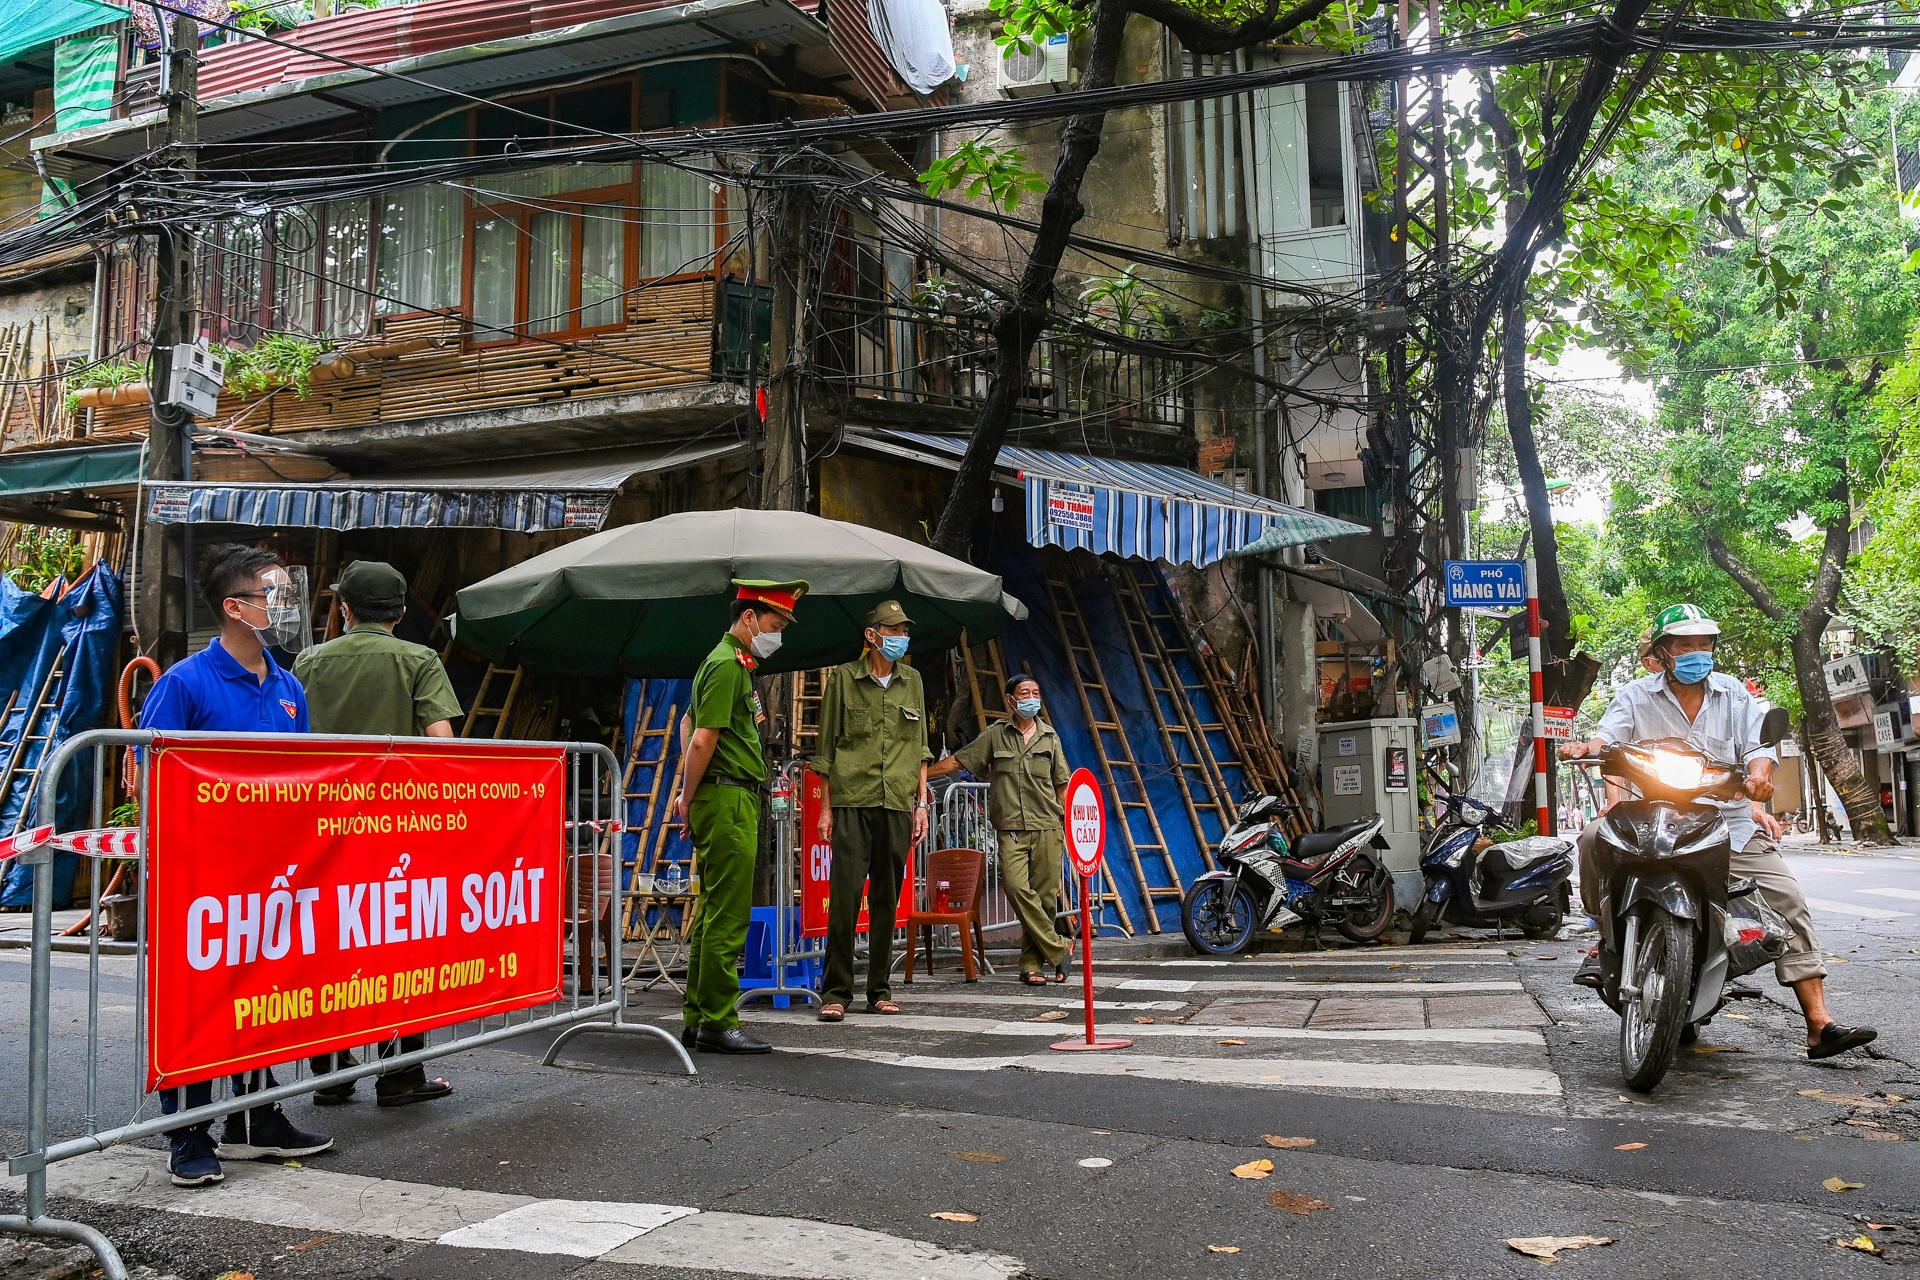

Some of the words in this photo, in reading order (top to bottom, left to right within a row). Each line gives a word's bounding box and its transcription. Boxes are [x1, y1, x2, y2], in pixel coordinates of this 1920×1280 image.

[1049, 508, 1093, 523] 092550.3888
[1050, 498, 1065, 510] PHÚ
[1067, 502, 1093, 515] THÀNH
[1480, 566, 1503, 578] PHỐ
[1452, 580, 1493, 599] HÀNG
[1496, 577, 1521, 599] VẢI
[1876, 715, 1890, 729] KANE
[1554, 726, 1570, 738] THẺ
[1878, 729, 1892, 742] CASE
[196, 778, 231, 803] SỞ
[236, 778, 270, 803] CHỈ
[275, 782, 314, 802] HUY
[318, 778, 376, 802] PHÒNG
[380, 778, 439, 800] CHỐNG
[442, 782, 477, 804] DỊCH
[480, 782, 520, 800] COVID
[531, 782, 546, 799] 19
[317, 811, 393, 837] PHƯỜNG
[397, 810, 442, 833] HÀNG
[446, 809, 468, 831] BỒ
[1072, 804, 1085, 821] KHU
[1086, 803, 1098, 825] VỰC
[1075, 822, 1097, 843] CẤM
[1076, 858, 1084, 871] NO
[1084, 857, 1098, 874] ENTRY
[186, 863, 320, 971] CHỐT
[336, 853, 448, 951] KIỂM
[460, 857, 545, 933] SOÁT
[234, 985, 314, 1030] PHÒNG
[320, 968, 388, 1015] CHỐNG
[392, 966, 435, 1005] DỊCH
[438, 958, 485, 991] COVID
[498, 952, 518, 980] 19
